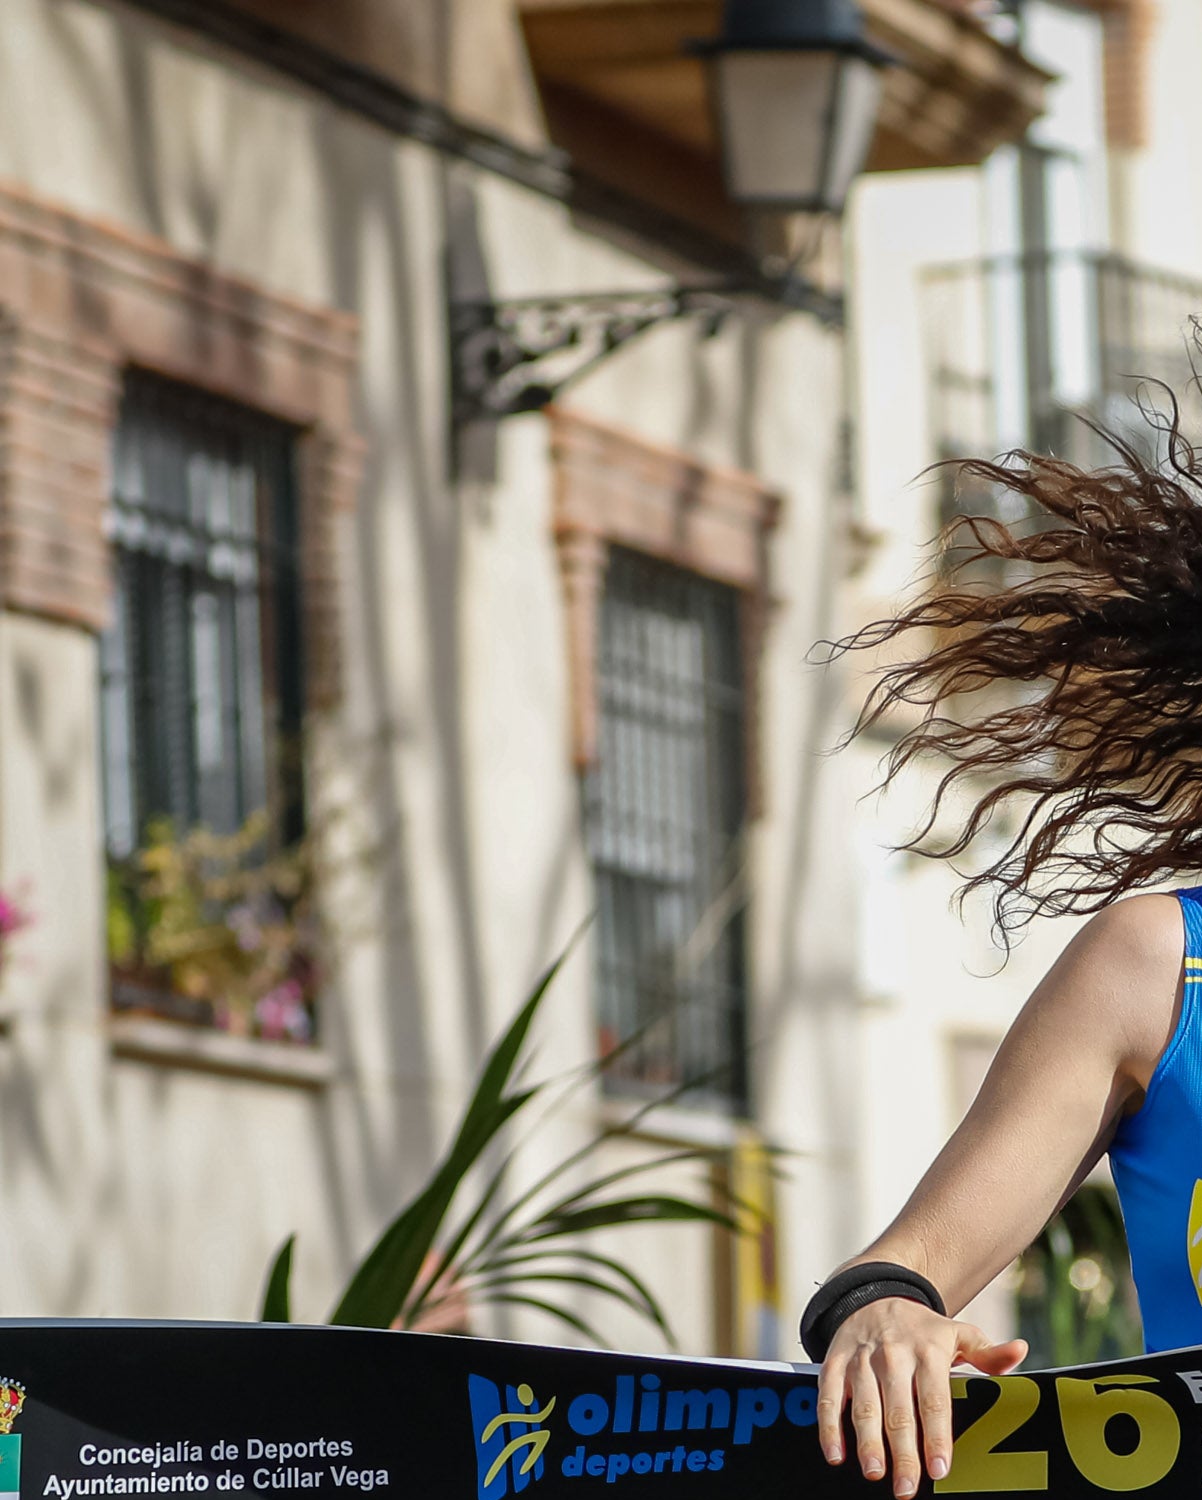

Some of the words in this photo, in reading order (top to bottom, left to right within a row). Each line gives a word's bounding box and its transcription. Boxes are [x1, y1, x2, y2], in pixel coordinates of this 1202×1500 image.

[567, 1374, 820, 1444] olimpo
[933, 1374, 1181, 1493] 26
[79, 1440, 203, 1468] Concejalía
[210, 1440, 239, 1461] de
[247, 1437, 353, 1464] Deportes
[561, 1446, 725, 1483] deportes
[42, 1471, 209, 1500] Ayuntamiento
[216, 1469, 245, 1491] de
[253, 1467, 324, 1489] Cúllar
[330, 1465, 389, 1491] Vega
